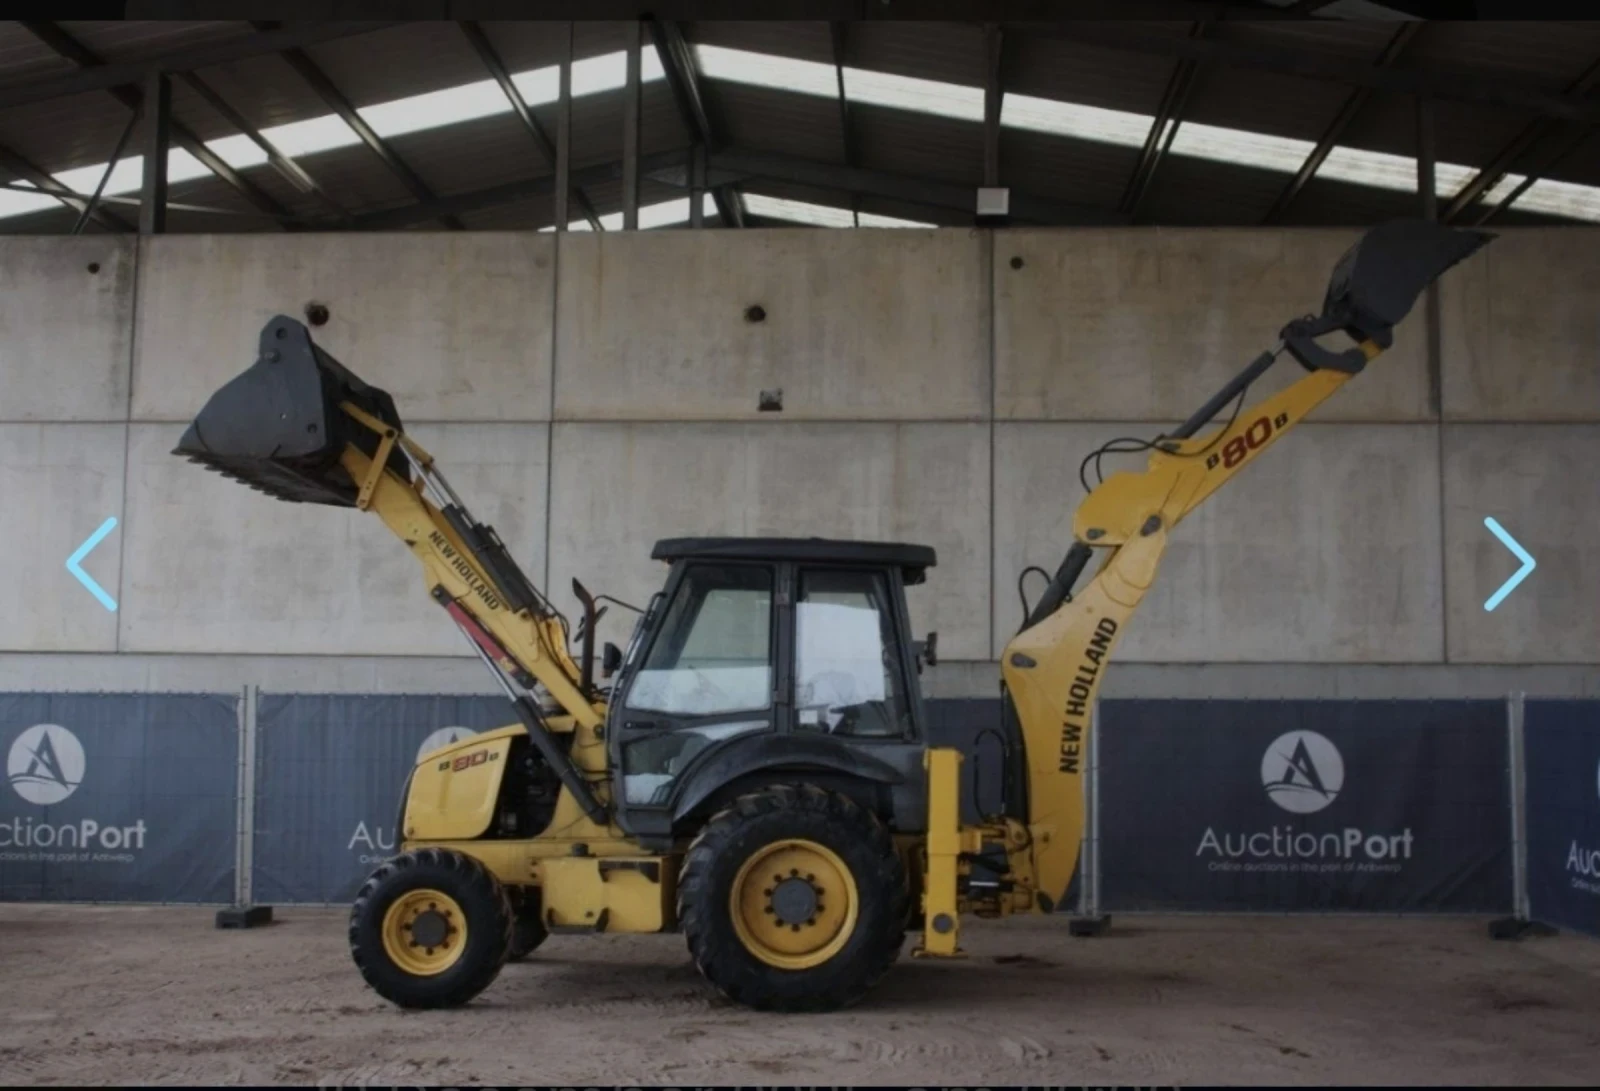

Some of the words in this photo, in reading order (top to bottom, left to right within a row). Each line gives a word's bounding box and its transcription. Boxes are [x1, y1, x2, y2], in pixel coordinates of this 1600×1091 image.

[428, 530, 455, 559] NEW
[451, 555, 500, 611] HOLLAND
[1065, 617, 1118, 717] HOLLAND
[1059, 721, 1082, 774] NEW
[1196, 825, 1414, 859] AuctionPort
